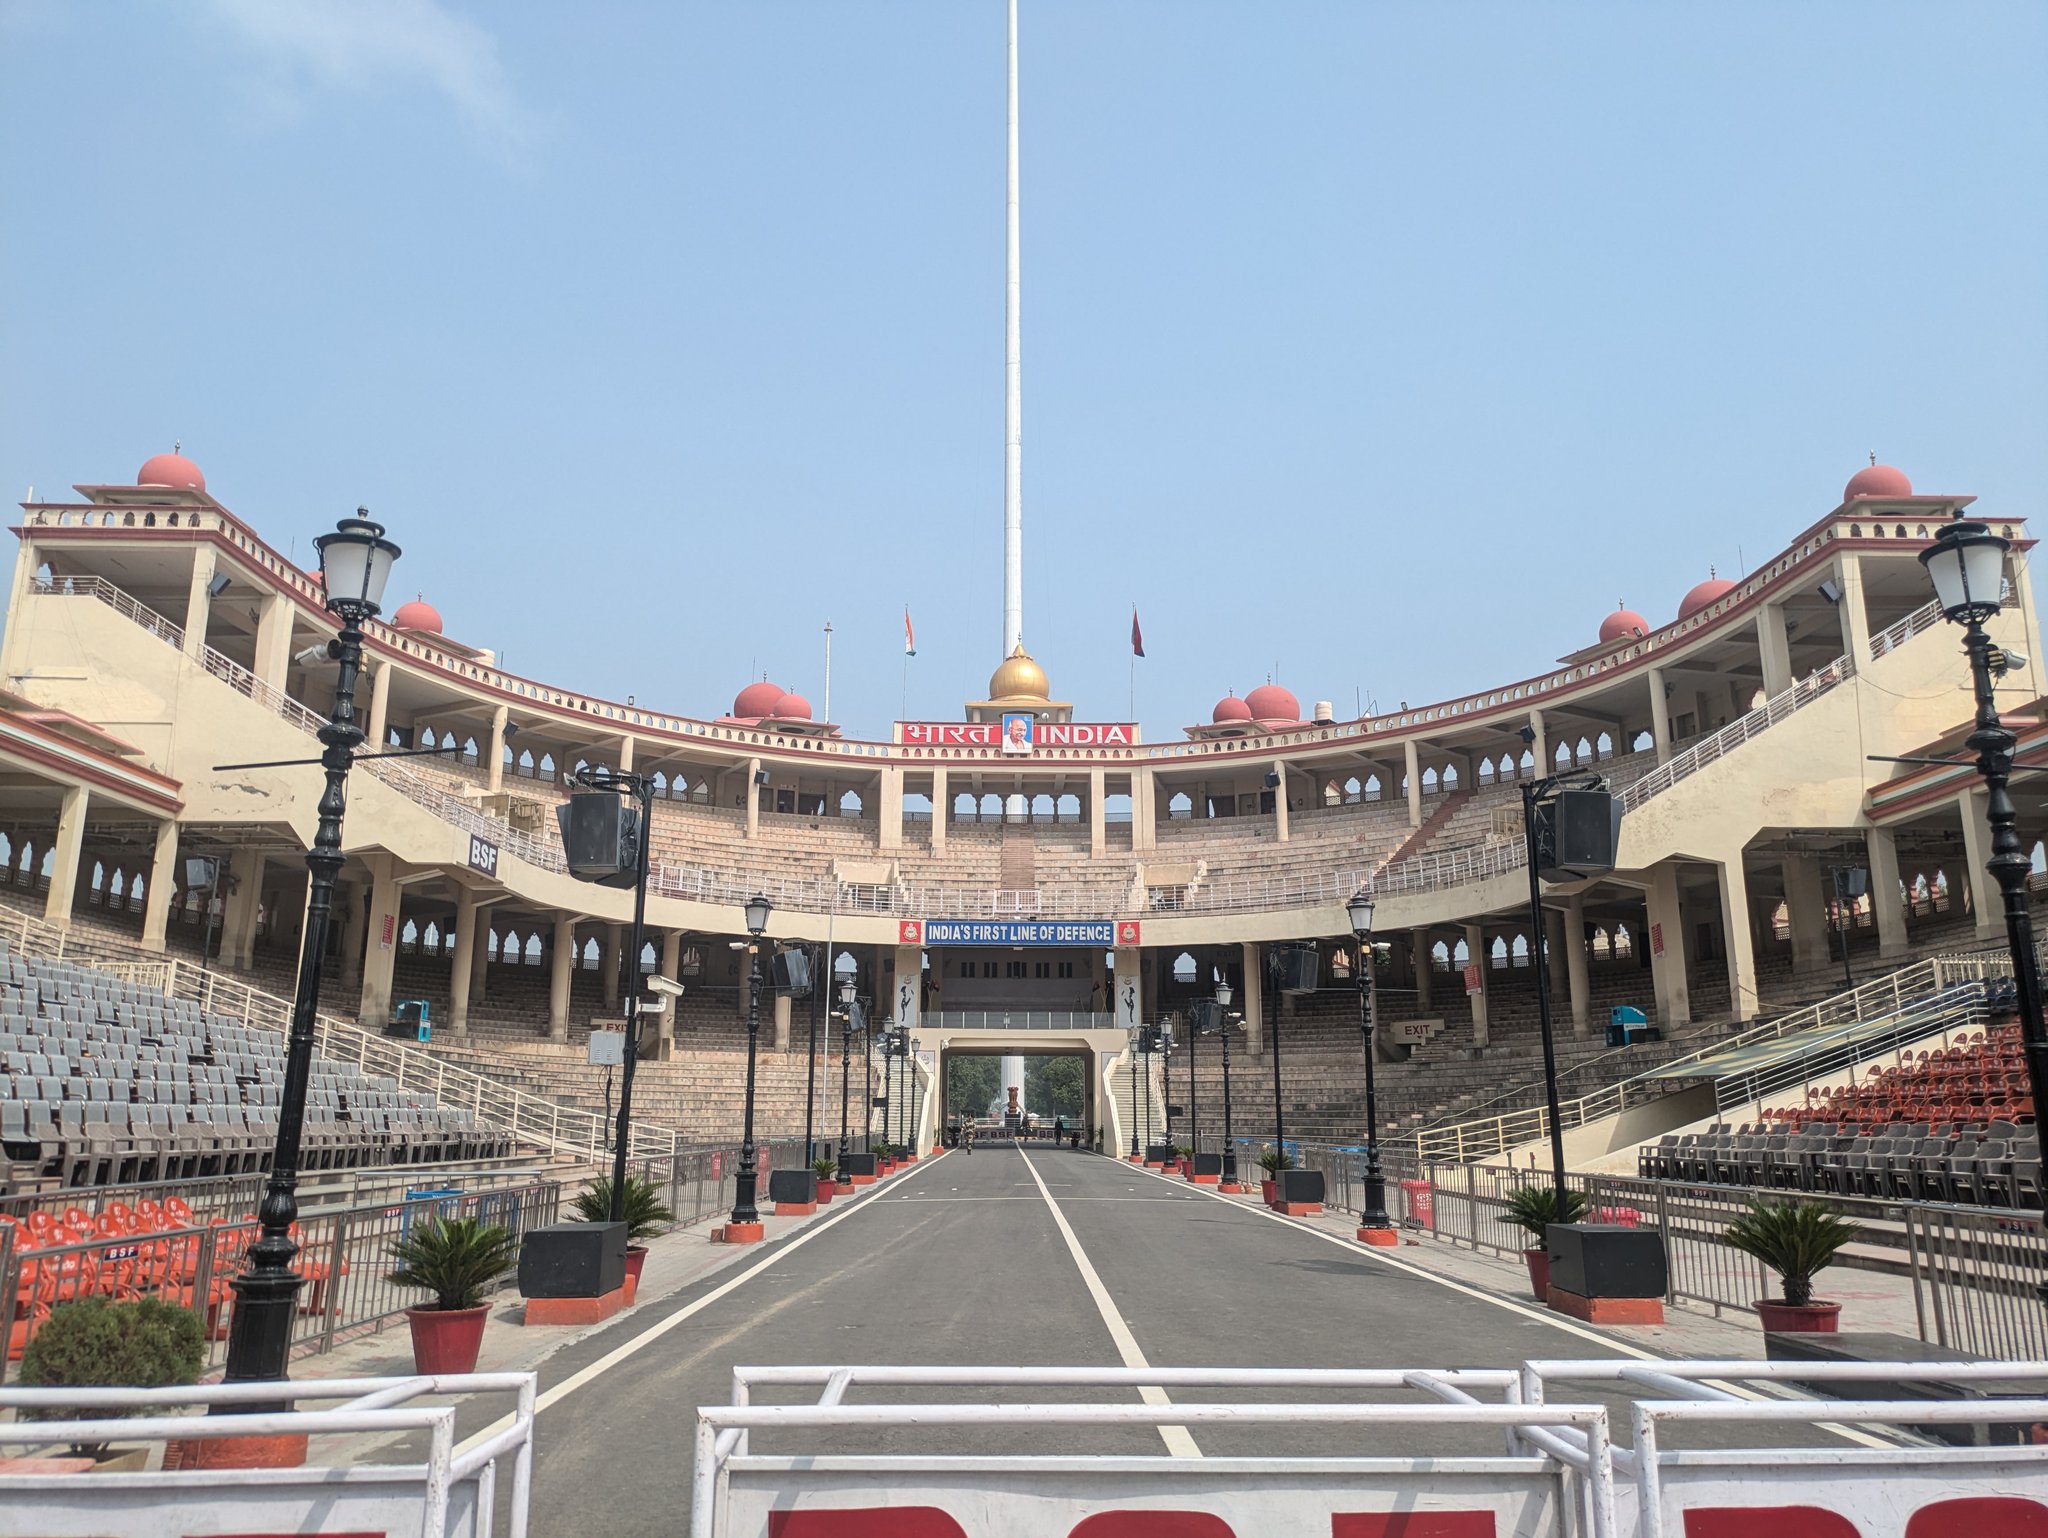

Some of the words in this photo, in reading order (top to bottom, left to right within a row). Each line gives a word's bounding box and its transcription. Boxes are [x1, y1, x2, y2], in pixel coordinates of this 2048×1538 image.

[907, 725, 993, 743] भारत
[1041, 726, 1128, 744] INDIA
[471, 839, 497, 870] BSF
[928, 925, 970, 940] INDIA'S
[973, 925, 1008, 940] FIRST
[1010, 926, 1037, 941] LINE
[1039, 926, 1054, 941] OF
[1057, 926, 1111, 941] DEFENCE
[1404, 1024, 1430, 1035] EXIT
[386, 1208, 400, 1217] BSF
[109, 1246, 135, 1258] BSF
